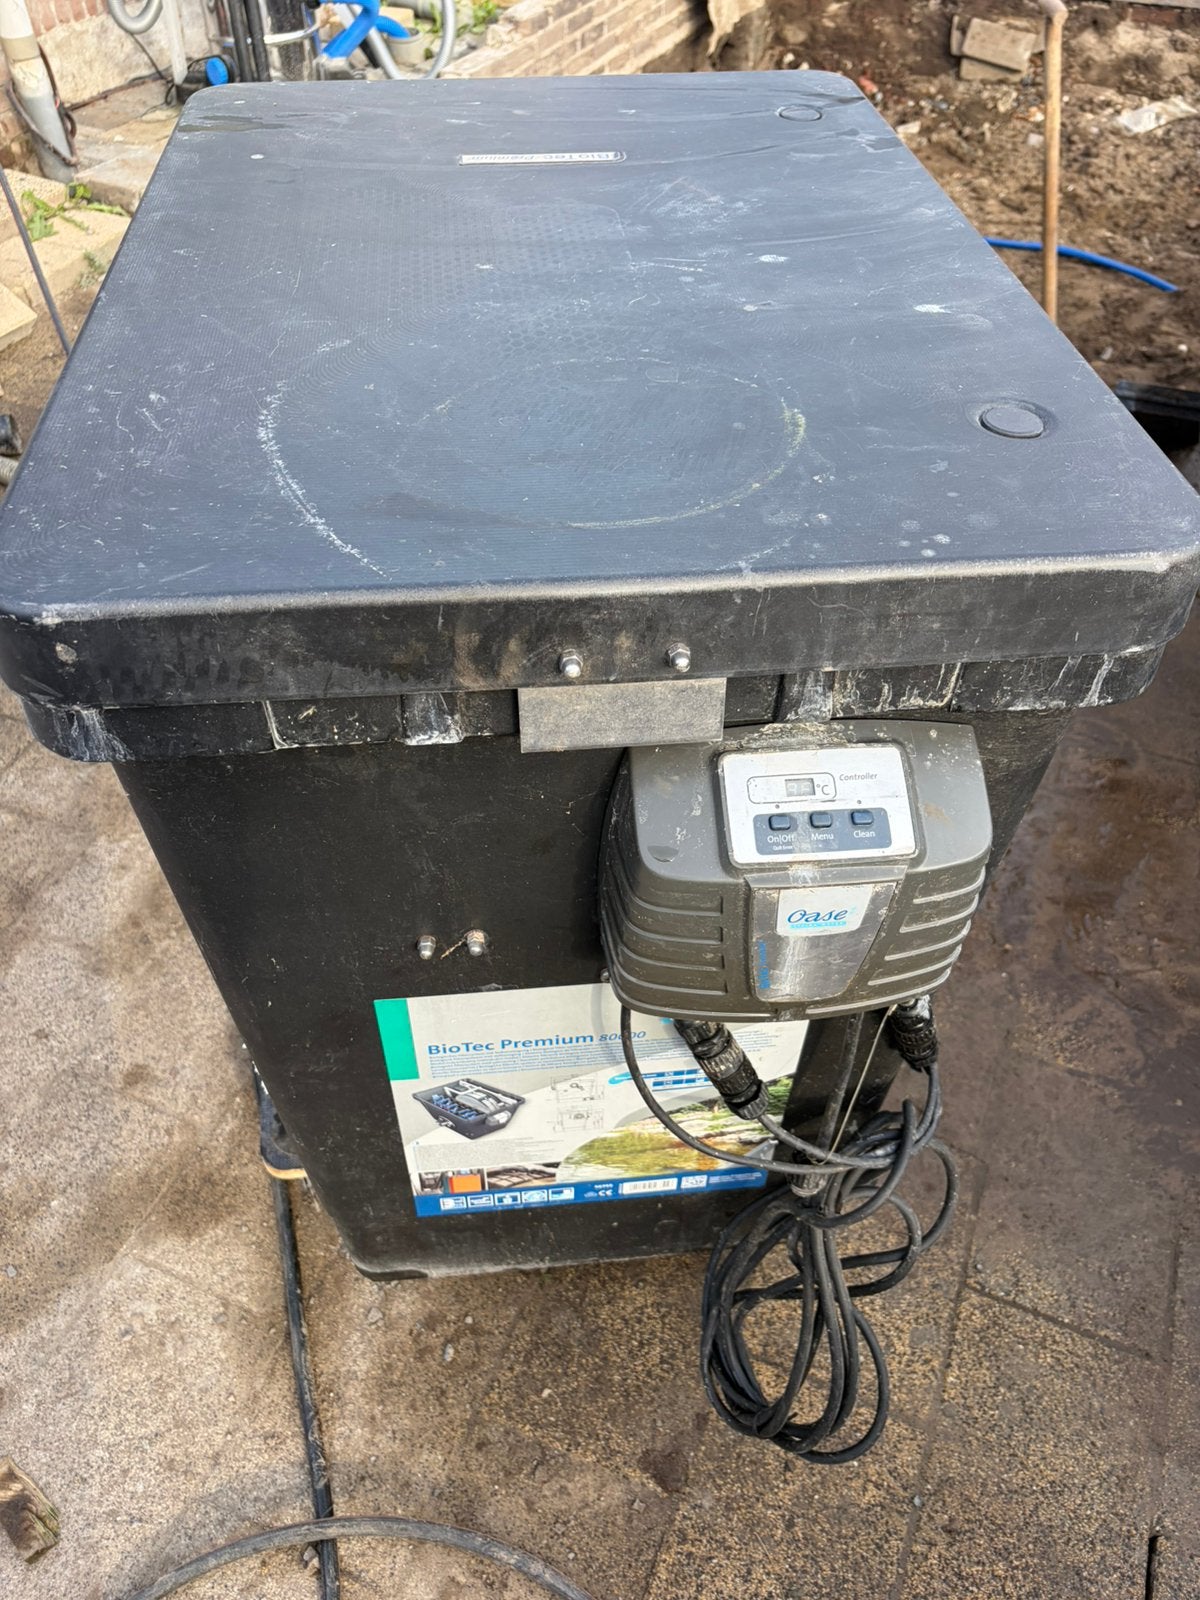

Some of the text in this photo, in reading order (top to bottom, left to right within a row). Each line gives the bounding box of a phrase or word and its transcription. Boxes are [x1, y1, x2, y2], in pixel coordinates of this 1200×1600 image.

[839, 772, 878, 781] Controller
[811, 832, 834, 841] Menu
[853, 830, 876, 839] Clean
[787, 908, 848, 924] Oase
[428, 1042, 494, 1055] BioTec
[500, 1033, 593, 1049] Premium
